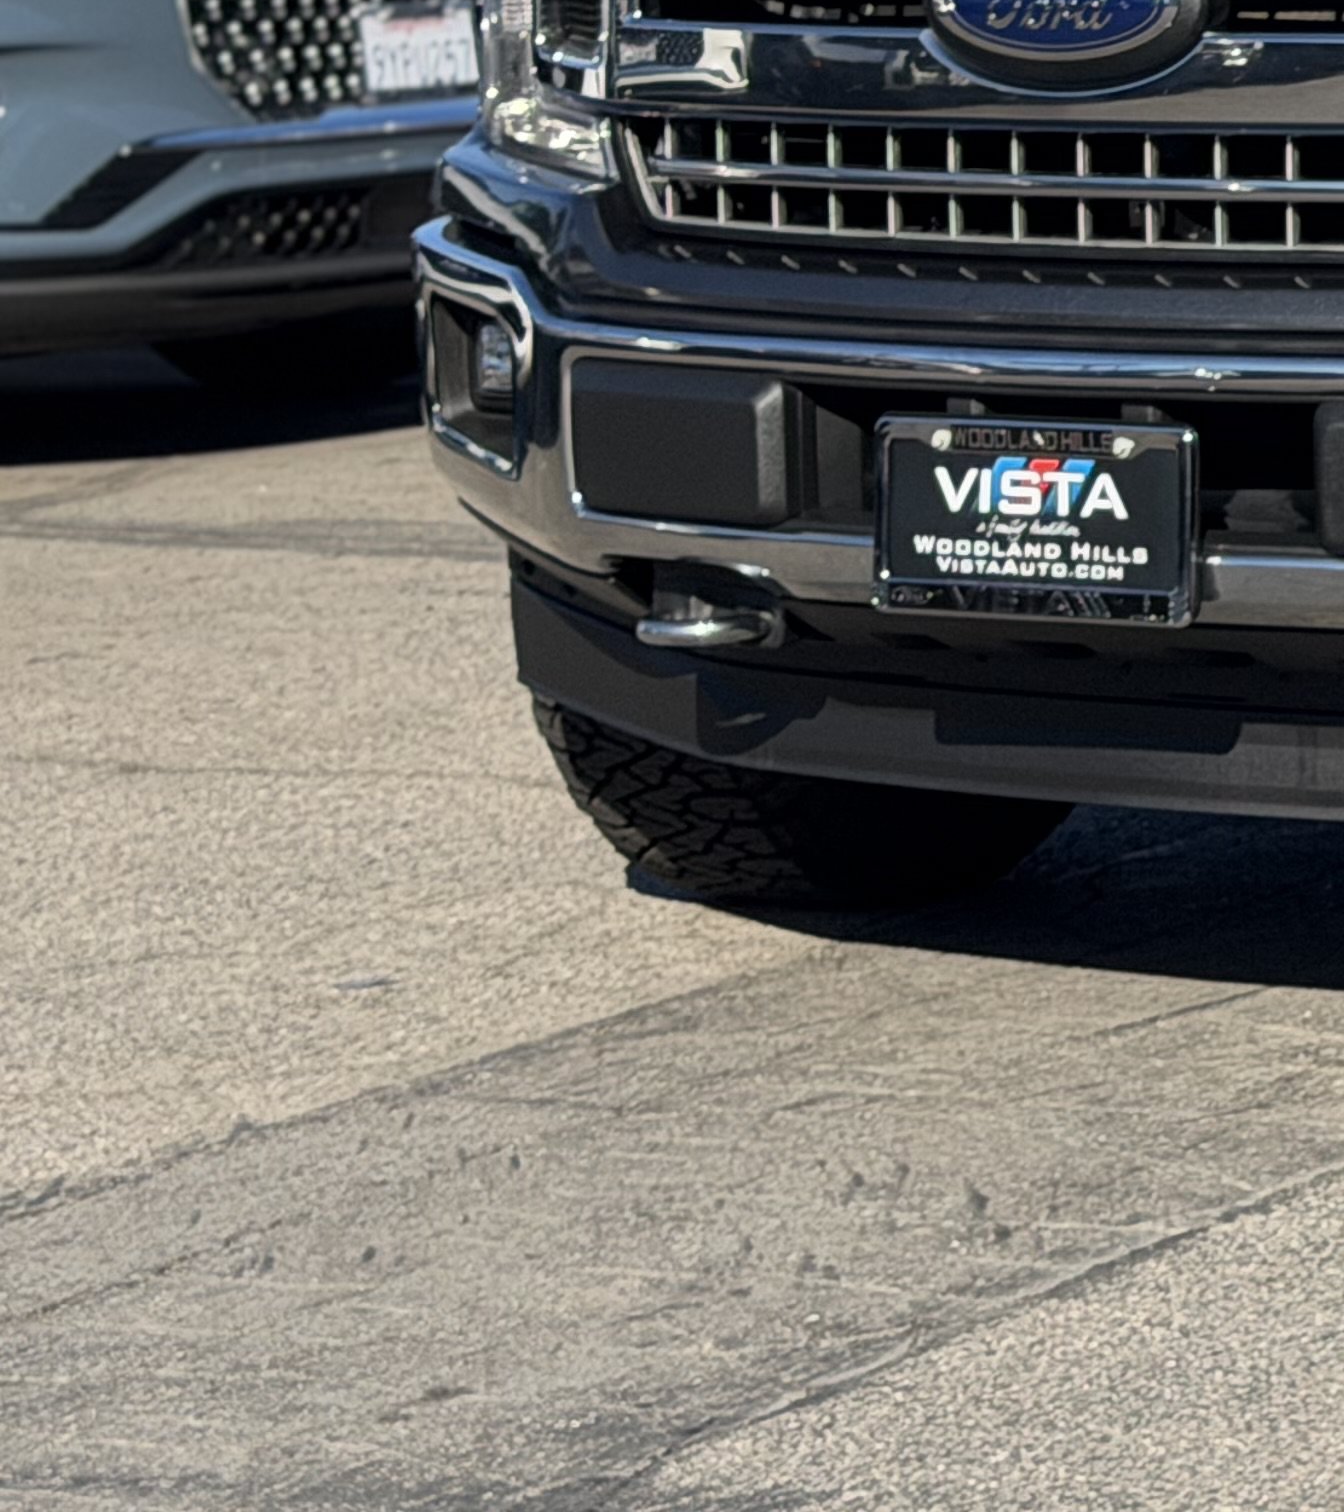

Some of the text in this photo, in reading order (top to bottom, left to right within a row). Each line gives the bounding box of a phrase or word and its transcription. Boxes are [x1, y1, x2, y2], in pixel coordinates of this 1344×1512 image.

[933, 465, 1130, 521] VISTA
[912, 534, 1149, 565] WOODLAND HILLS
